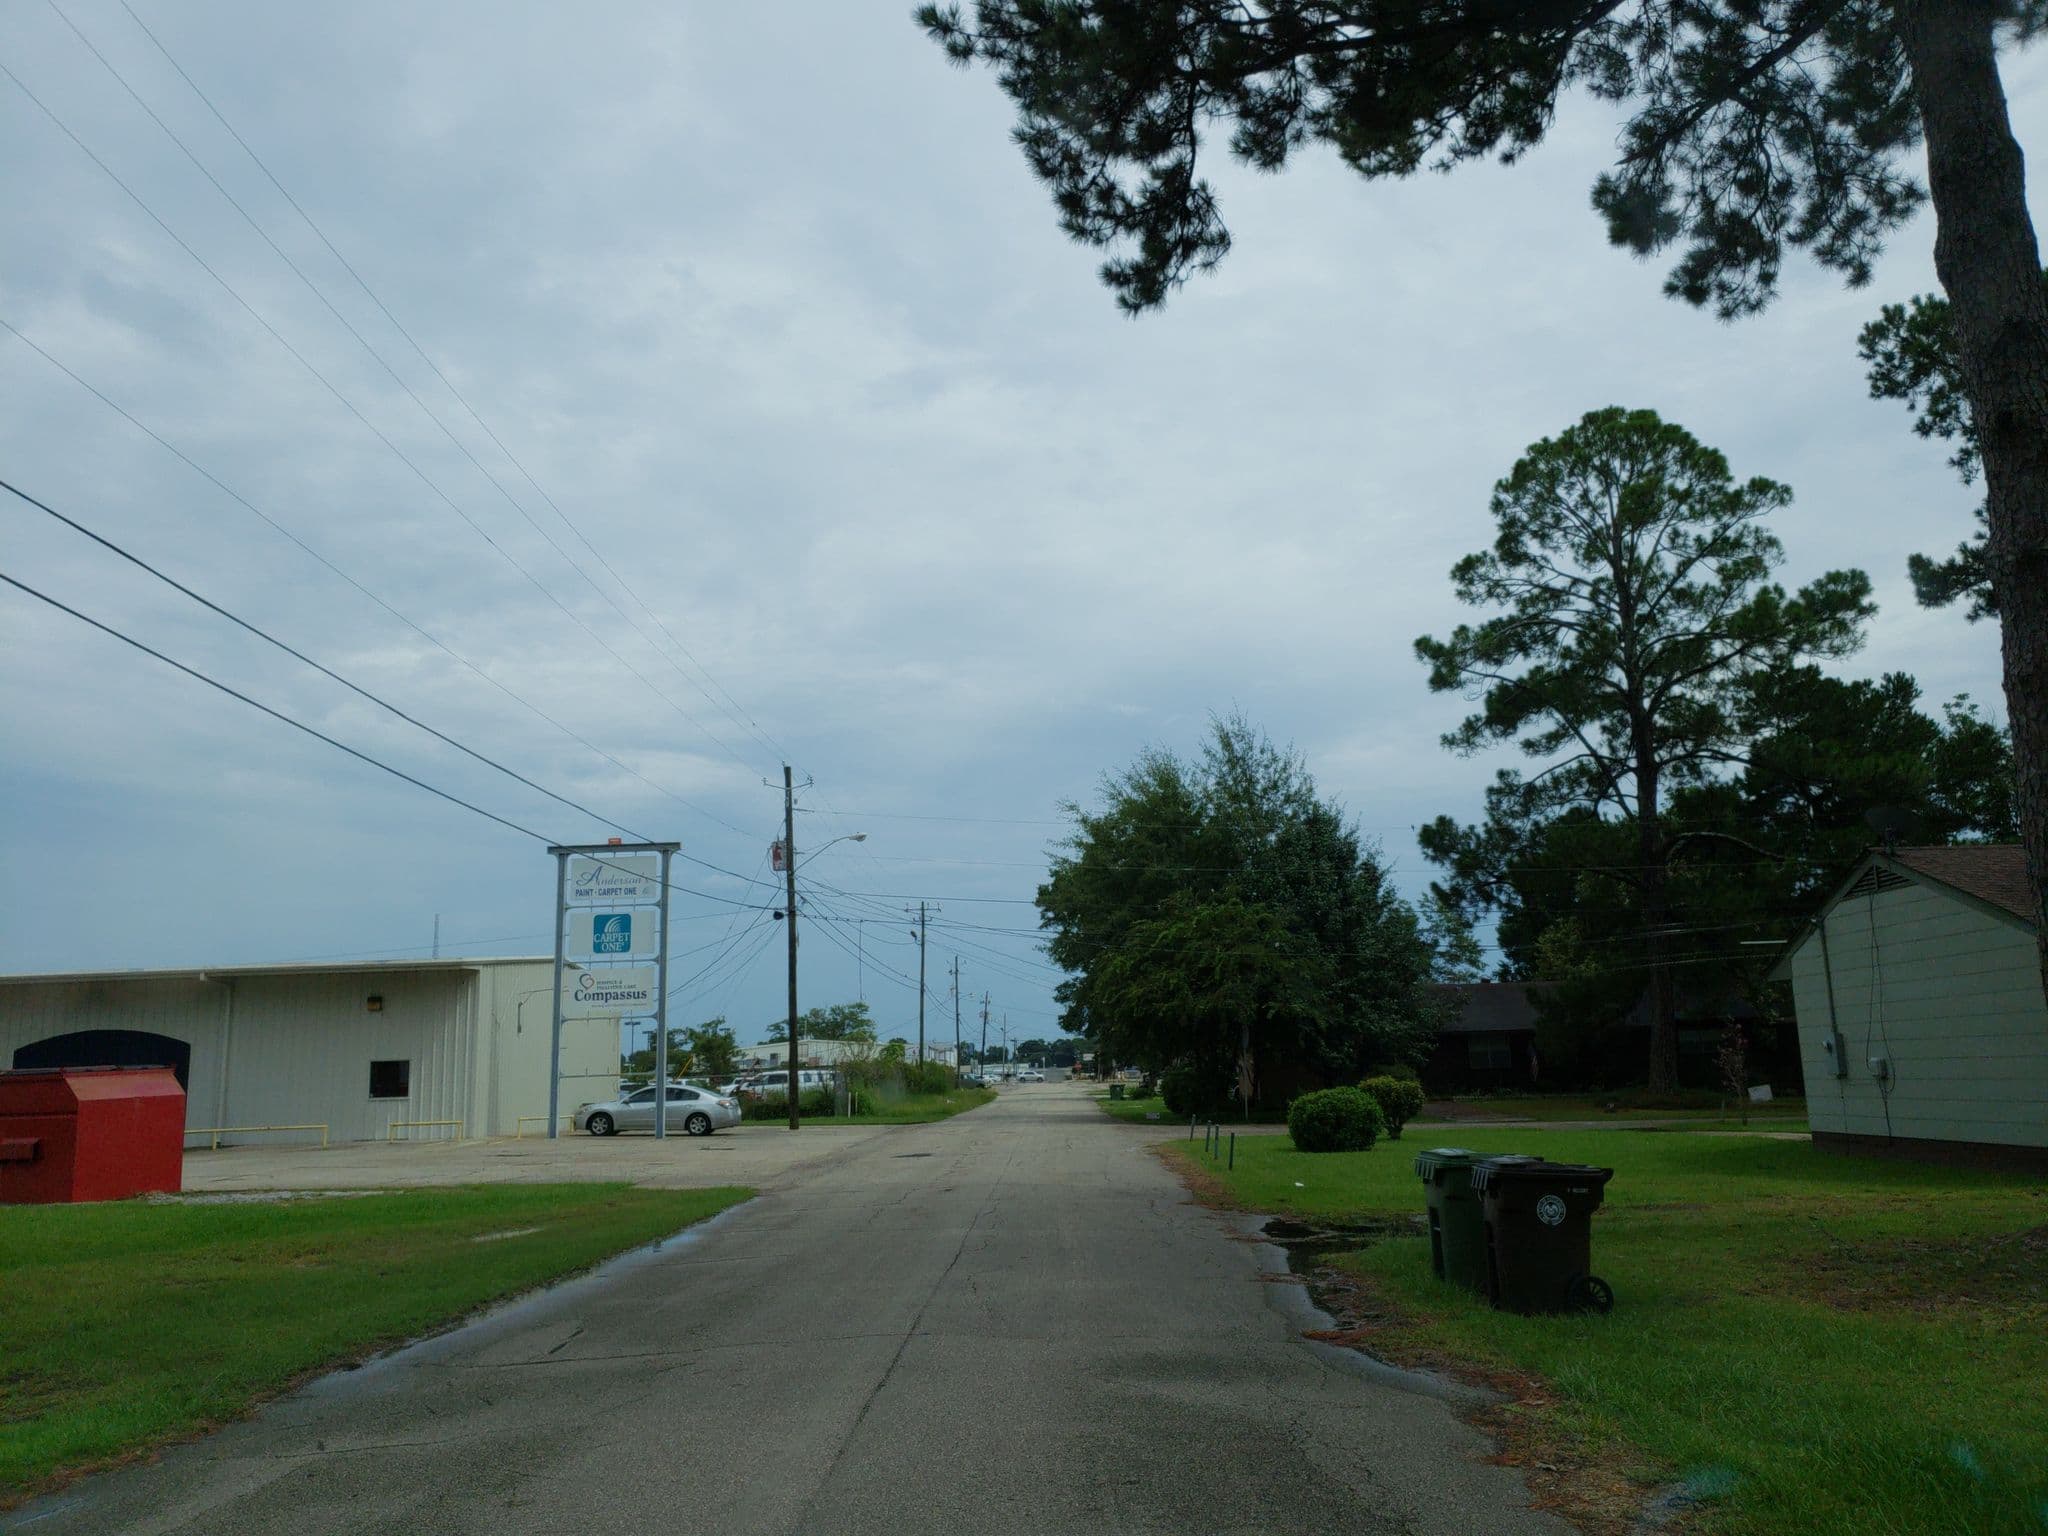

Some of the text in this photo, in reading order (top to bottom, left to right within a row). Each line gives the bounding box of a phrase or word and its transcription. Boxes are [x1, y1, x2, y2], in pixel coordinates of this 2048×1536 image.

[575, 888, 594, 897] PAINT
[598, 887, 622, 896] CARPET
[624, 886, 637, 896] ONE
[594, 932, 630, 943] CARPET
[574, 989, 647, 1003] Compassus
